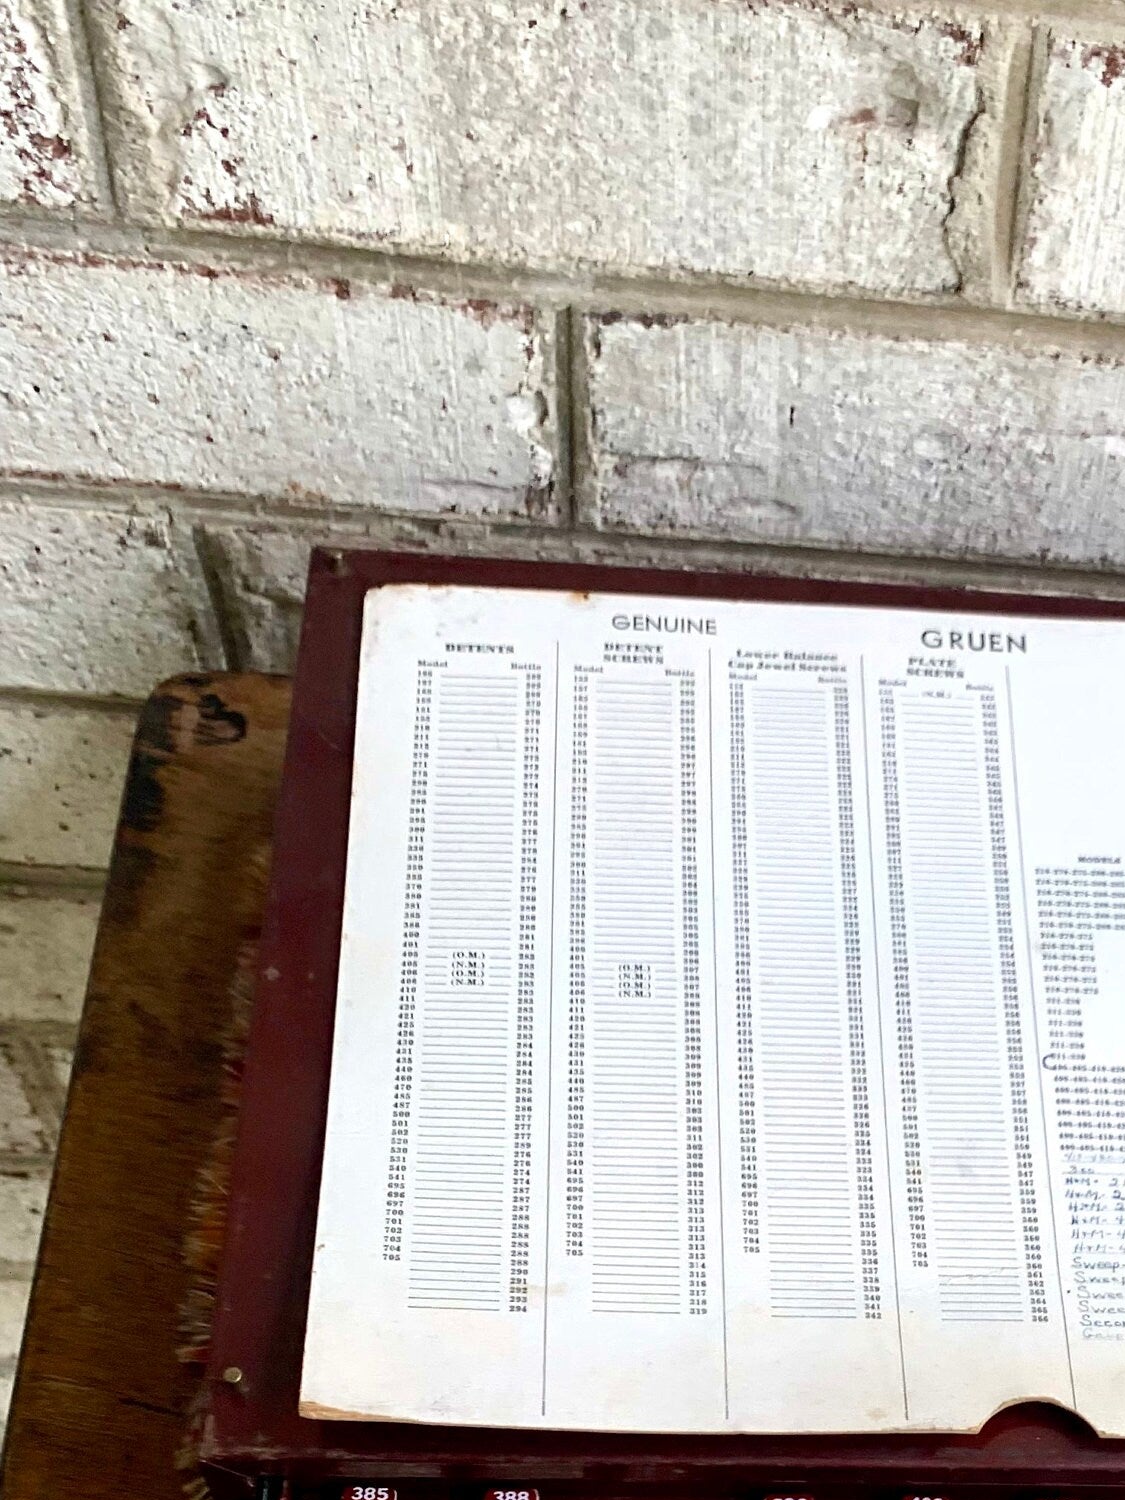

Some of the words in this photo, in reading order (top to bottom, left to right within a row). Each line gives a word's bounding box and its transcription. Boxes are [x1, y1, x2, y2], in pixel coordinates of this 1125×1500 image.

[612, 615, 717, 635] GENUINE
[921, 629, 1027, 654] GRUEN
[445, 643, 515, 654] DETENTS
[603, 654, 664, 664] SCREWS
[351, 1487, 389, 1500] 385
